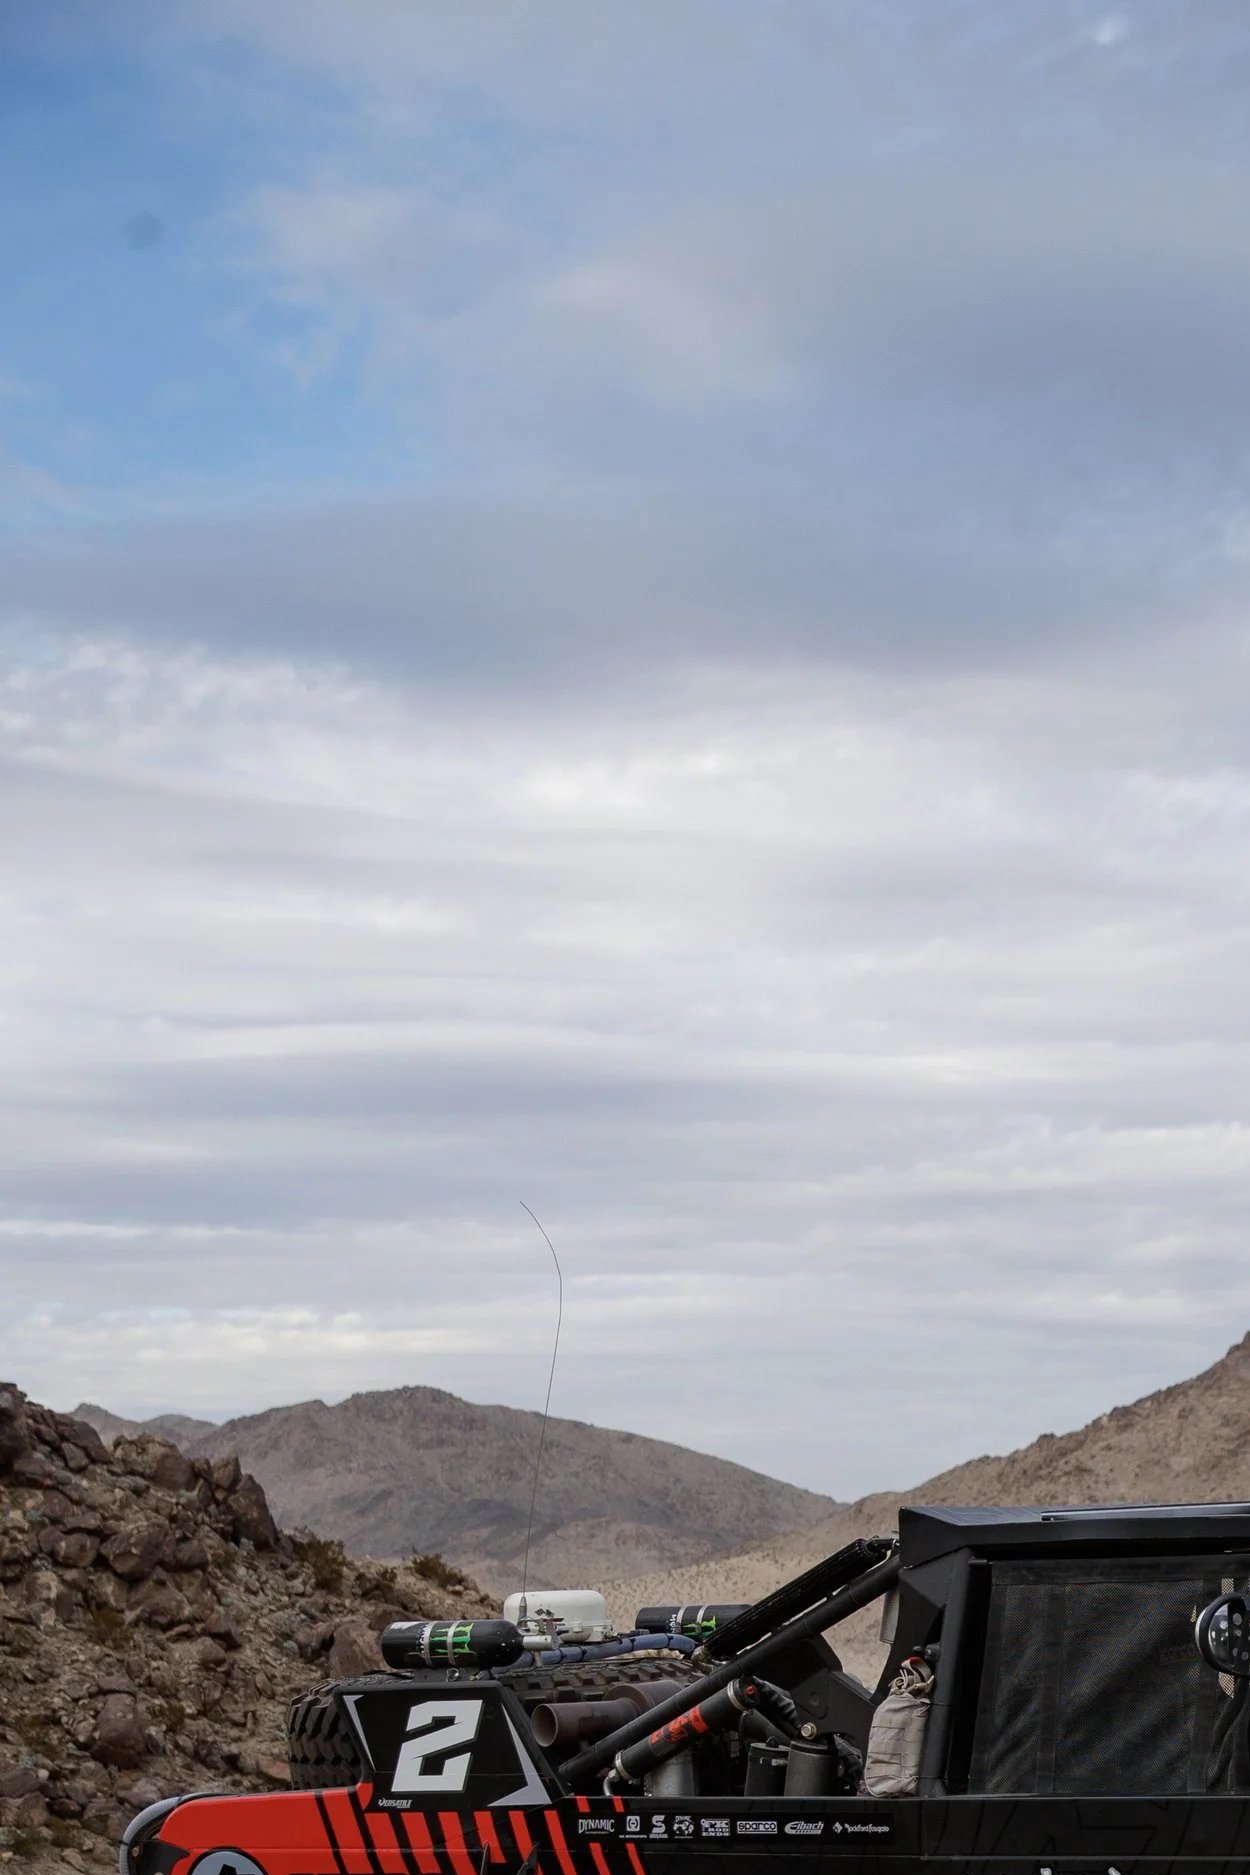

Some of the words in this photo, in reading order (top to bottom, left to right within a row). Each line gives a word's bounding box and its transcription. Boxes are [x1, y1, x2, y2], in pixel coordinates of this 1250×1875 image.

[391, 1700, 483, 1792] 2
[578, 1818, 615, 1834] DYNAMIC
[738, 1821, 777, 1831] sparco
[784, 1821, 825, 1834] Eibach
